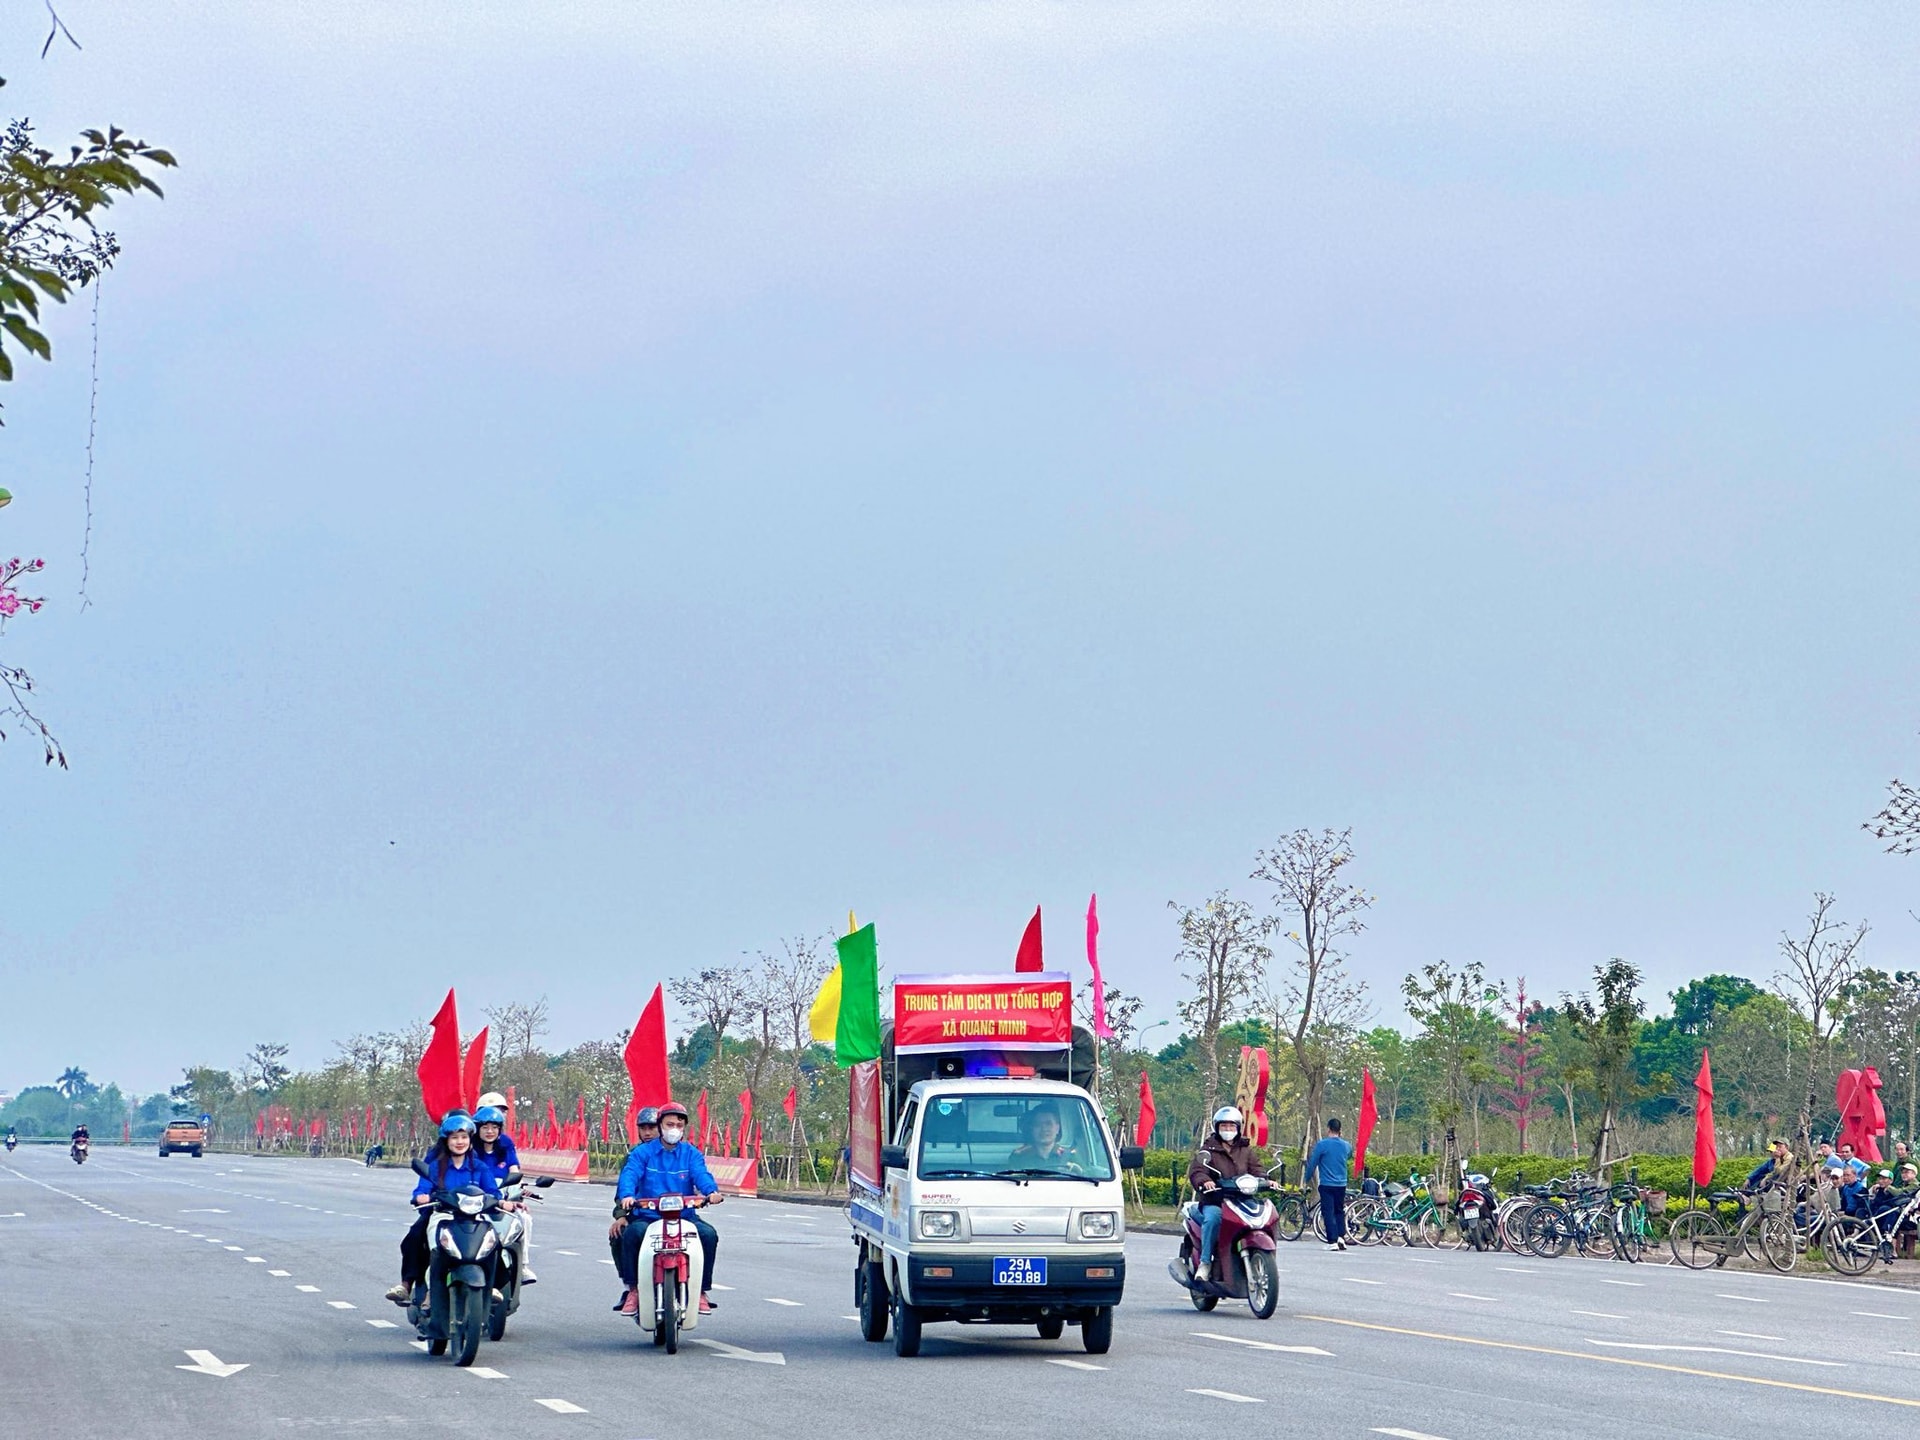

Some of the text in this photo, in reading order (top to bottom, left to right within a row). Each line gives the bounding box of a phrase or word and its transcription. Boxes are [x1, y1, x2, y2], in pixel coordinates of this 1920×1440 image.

[904, 987, 1064, 1014] TRUNG TÂM DỊCH VỤ TỔNG HỢP
[942, 1018, 1027, 1037] XÃ QUANG MINH
[1009, 1258, 1031, 1271] 29A
[999, 1271, 1041, 1283] 029.88
